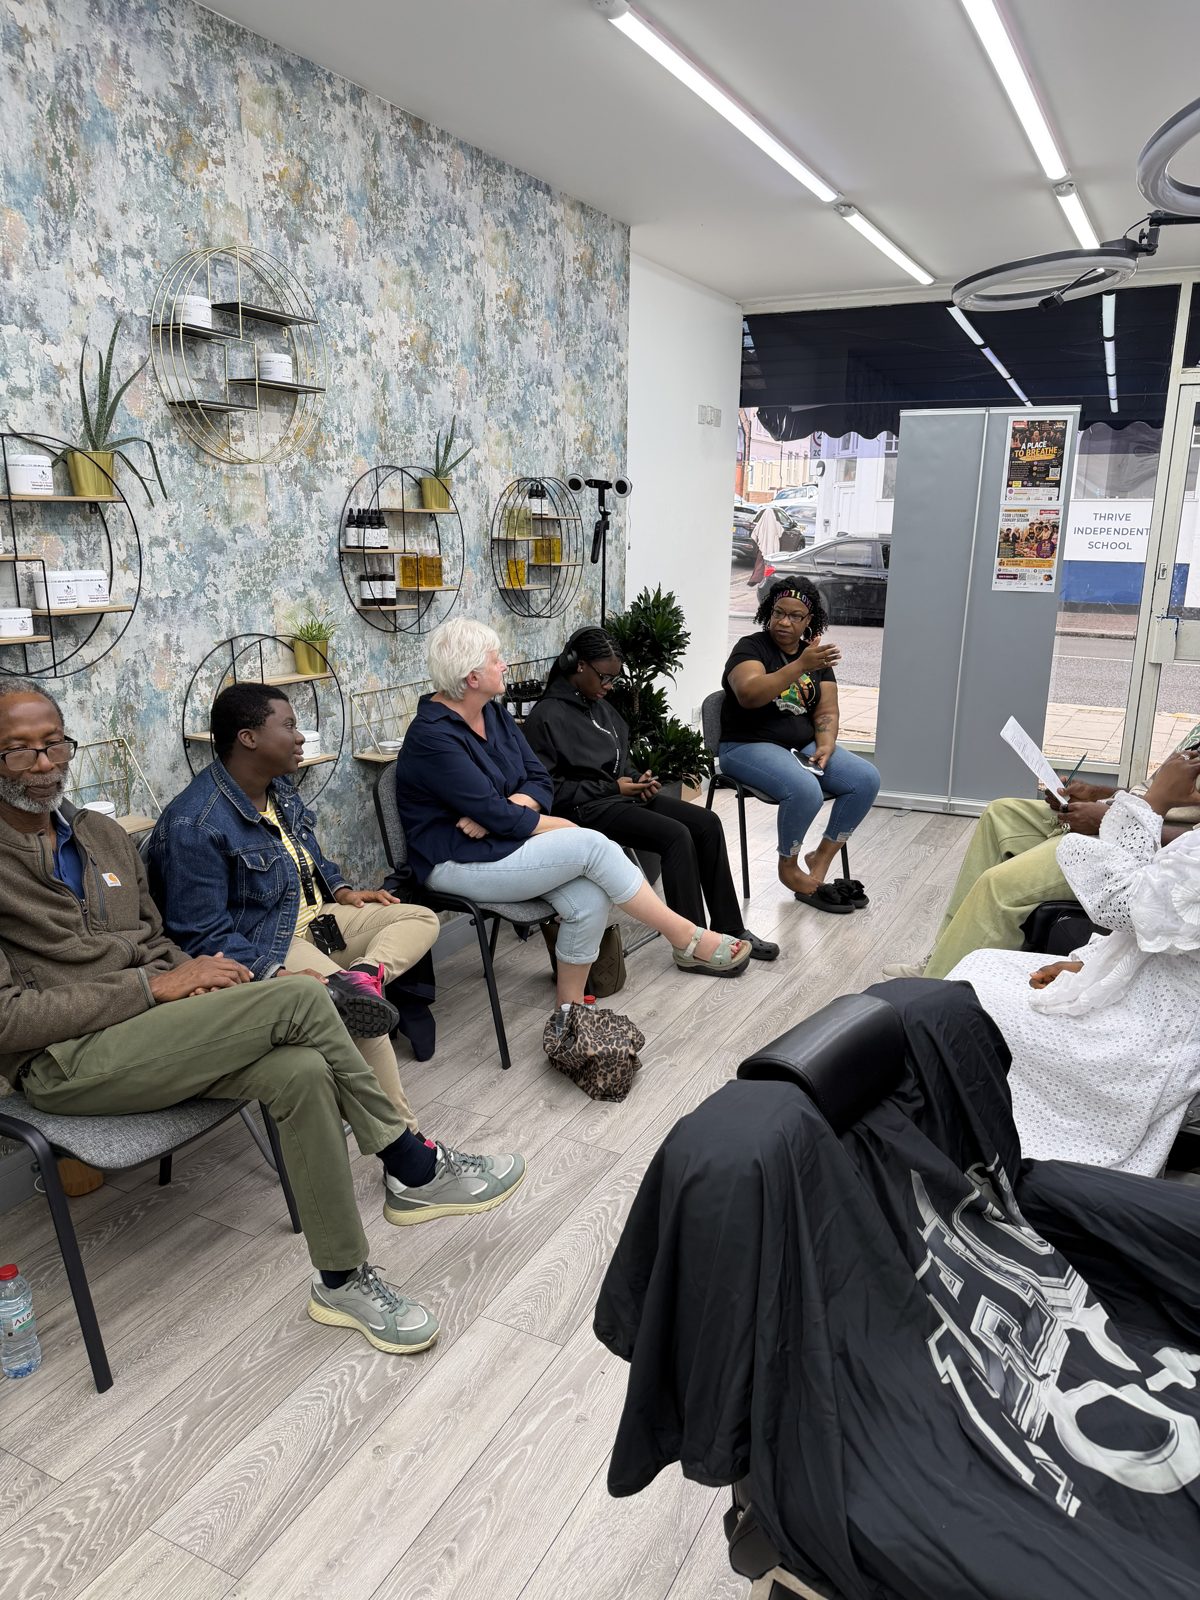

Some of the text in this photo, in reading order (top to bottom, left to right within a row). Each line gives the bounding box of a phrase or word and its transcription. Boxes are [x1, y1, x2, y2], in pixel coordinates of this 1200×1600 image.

[1027, 440, 1048, 449] PLACE
[1014, 449, 1024, 458] TO
[1025, 446, 1058, 457] BREATHE
[1092, 512, 1132, 522] THRIVE
[1073, 526, 1150, 536] INDEPENDENT
[1087, 541, 1133, 550] SCHOOL
[14, 1309, 33, 1327] ALP
